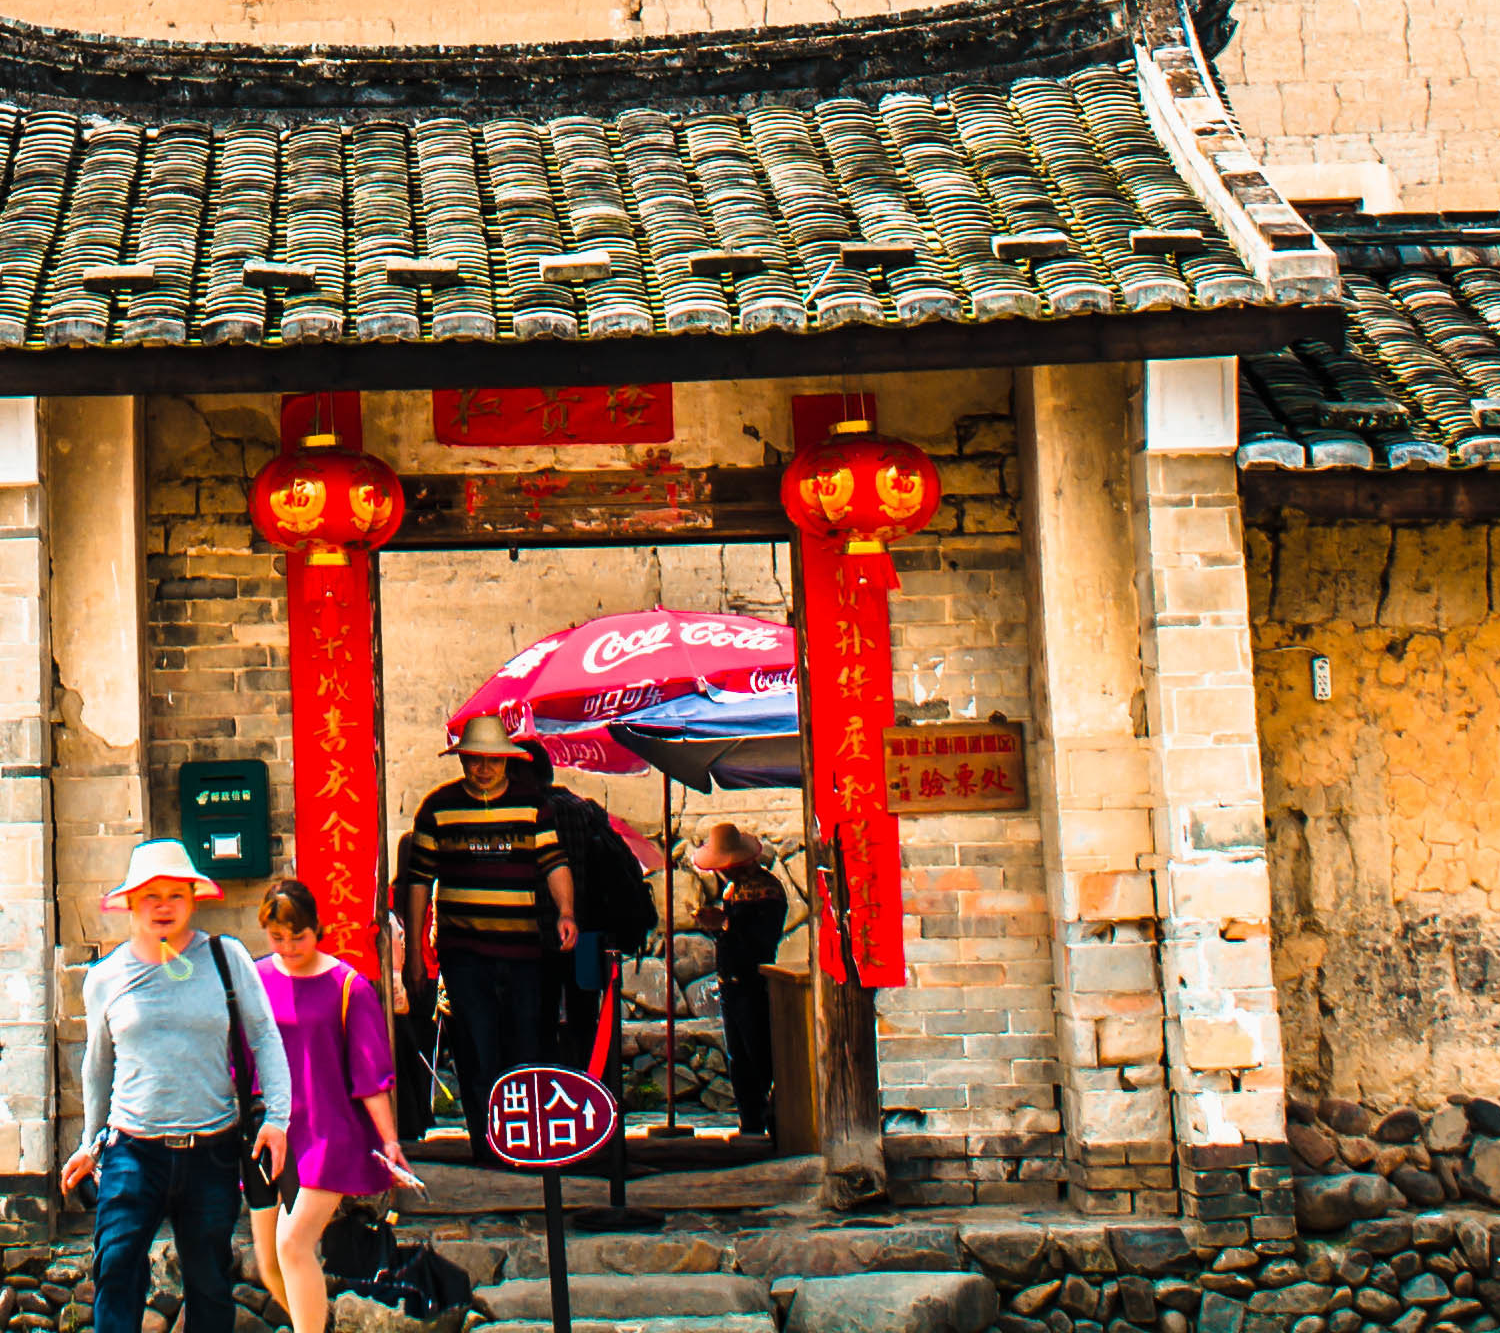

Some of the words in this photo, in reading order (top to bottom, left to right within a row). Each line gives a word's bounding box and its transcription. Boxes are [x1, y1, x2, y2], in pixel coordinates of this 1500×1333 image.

[583, 622, 674, 674] Coca
[680, 621, 783, 651] Cola
[918, 763, 1015, 799] 验票处
[503, 1081, 531, 1149] 出口
[543, 1079, 579, 1147] 入口
